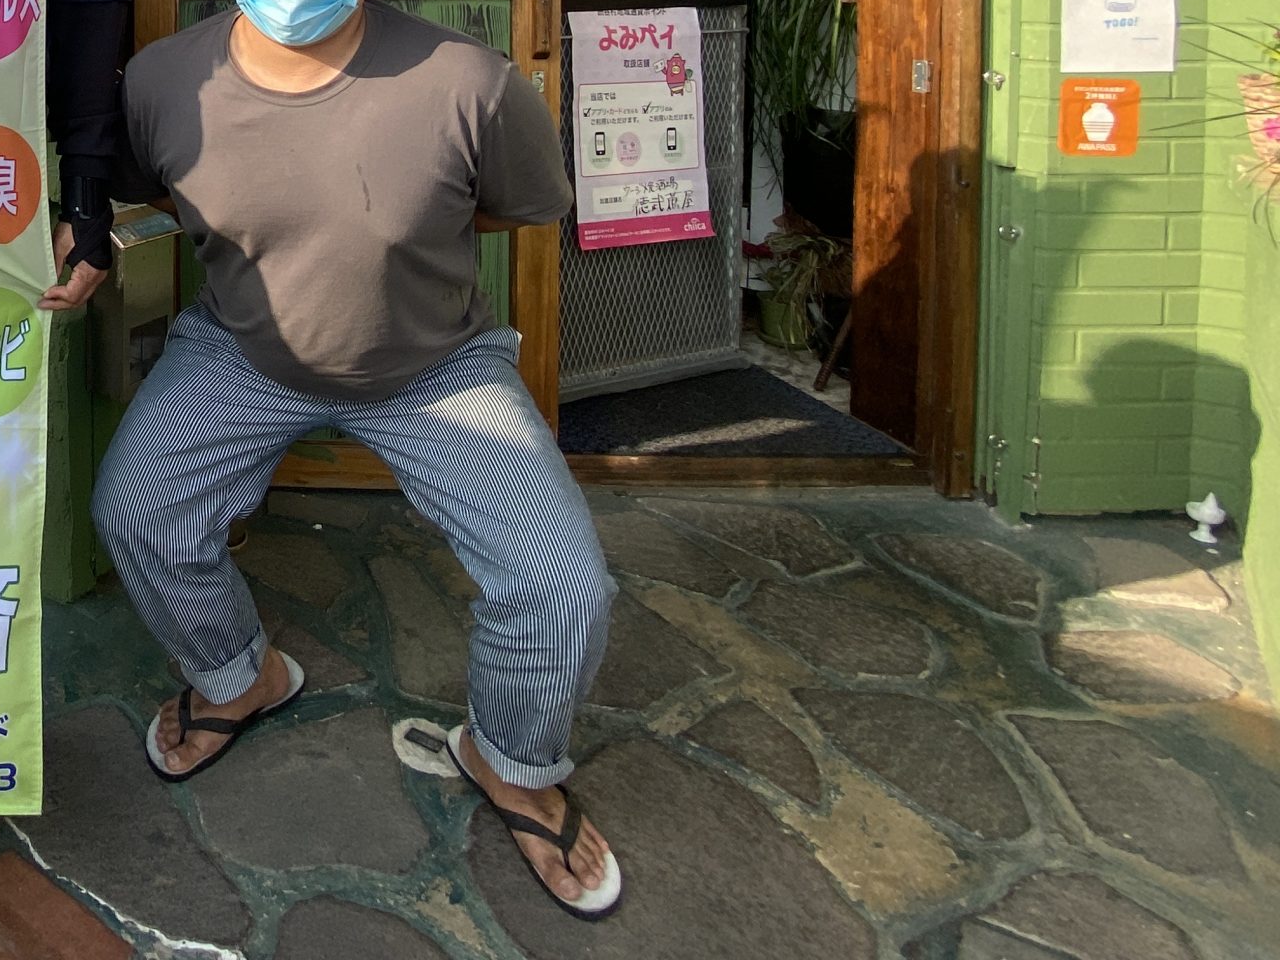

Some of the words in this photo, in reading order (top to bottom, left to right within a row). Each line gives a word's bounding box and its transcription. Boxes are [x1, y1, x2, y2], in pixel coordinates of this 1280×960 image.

[598, 23, 674, 51] よみペイ
[623, 59, 650, 69] 取扱店舗
[590, 92, 616, 101] 当店では
[684, 221, 706, 232] chiica
